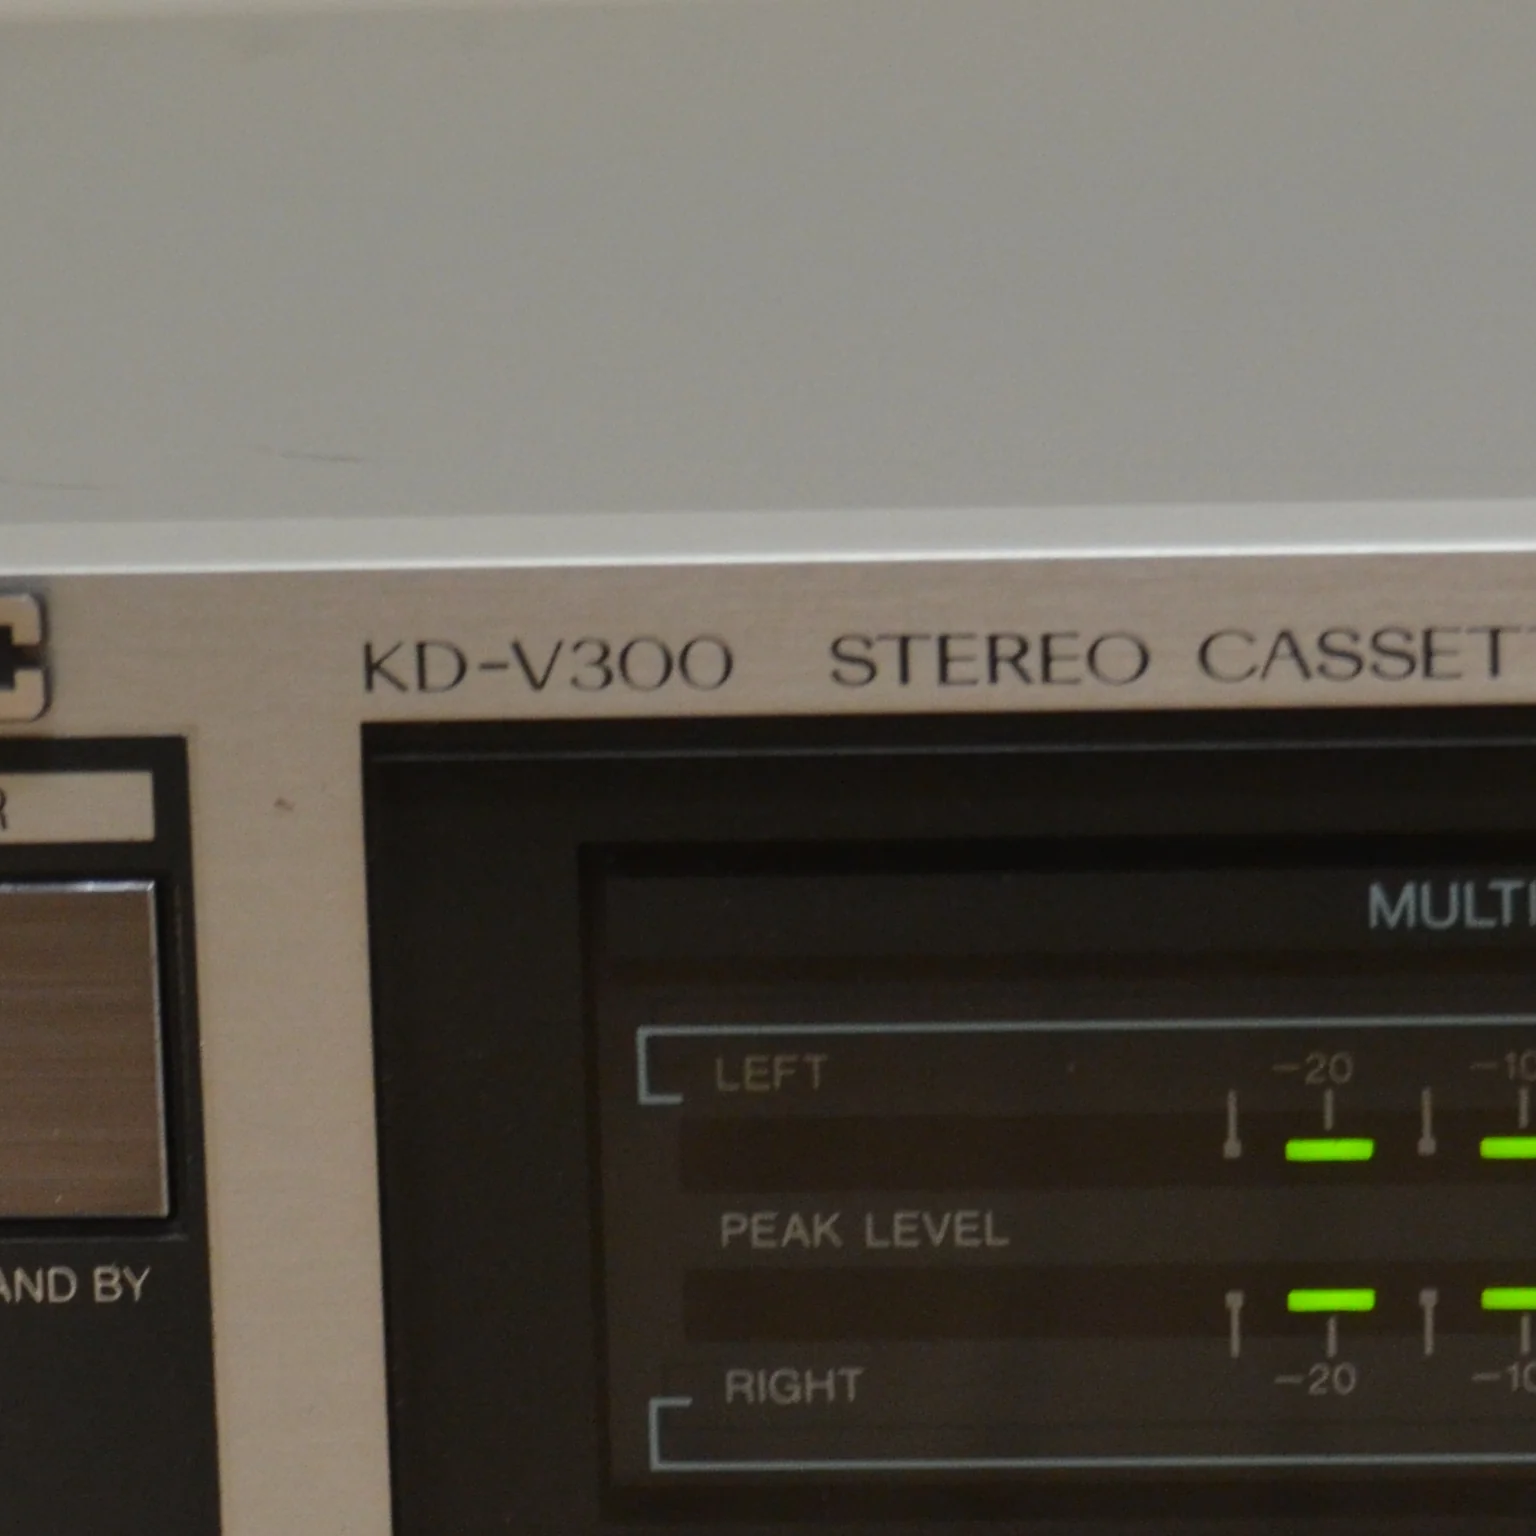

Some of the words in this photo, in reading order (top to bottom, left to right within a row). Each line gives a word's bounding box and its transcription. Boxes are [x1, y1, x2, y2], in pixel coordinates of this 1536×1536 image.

[362, 634, 734, 693] KD-V300
[829, 631, 1150, 688] STEREO
[715, 1053, 827, 1092] LEFT
[1272, 1052, 1354, 1086] -20
[720, 1212, 843, 1249] PEAK
[864, 1210, 1010, 1247] LEVEL
[94, 1265, 151, 1302] BY
[725, 1367, 864, 1405] RIGHT
[1274, 1362, 1357, 1396] -20
